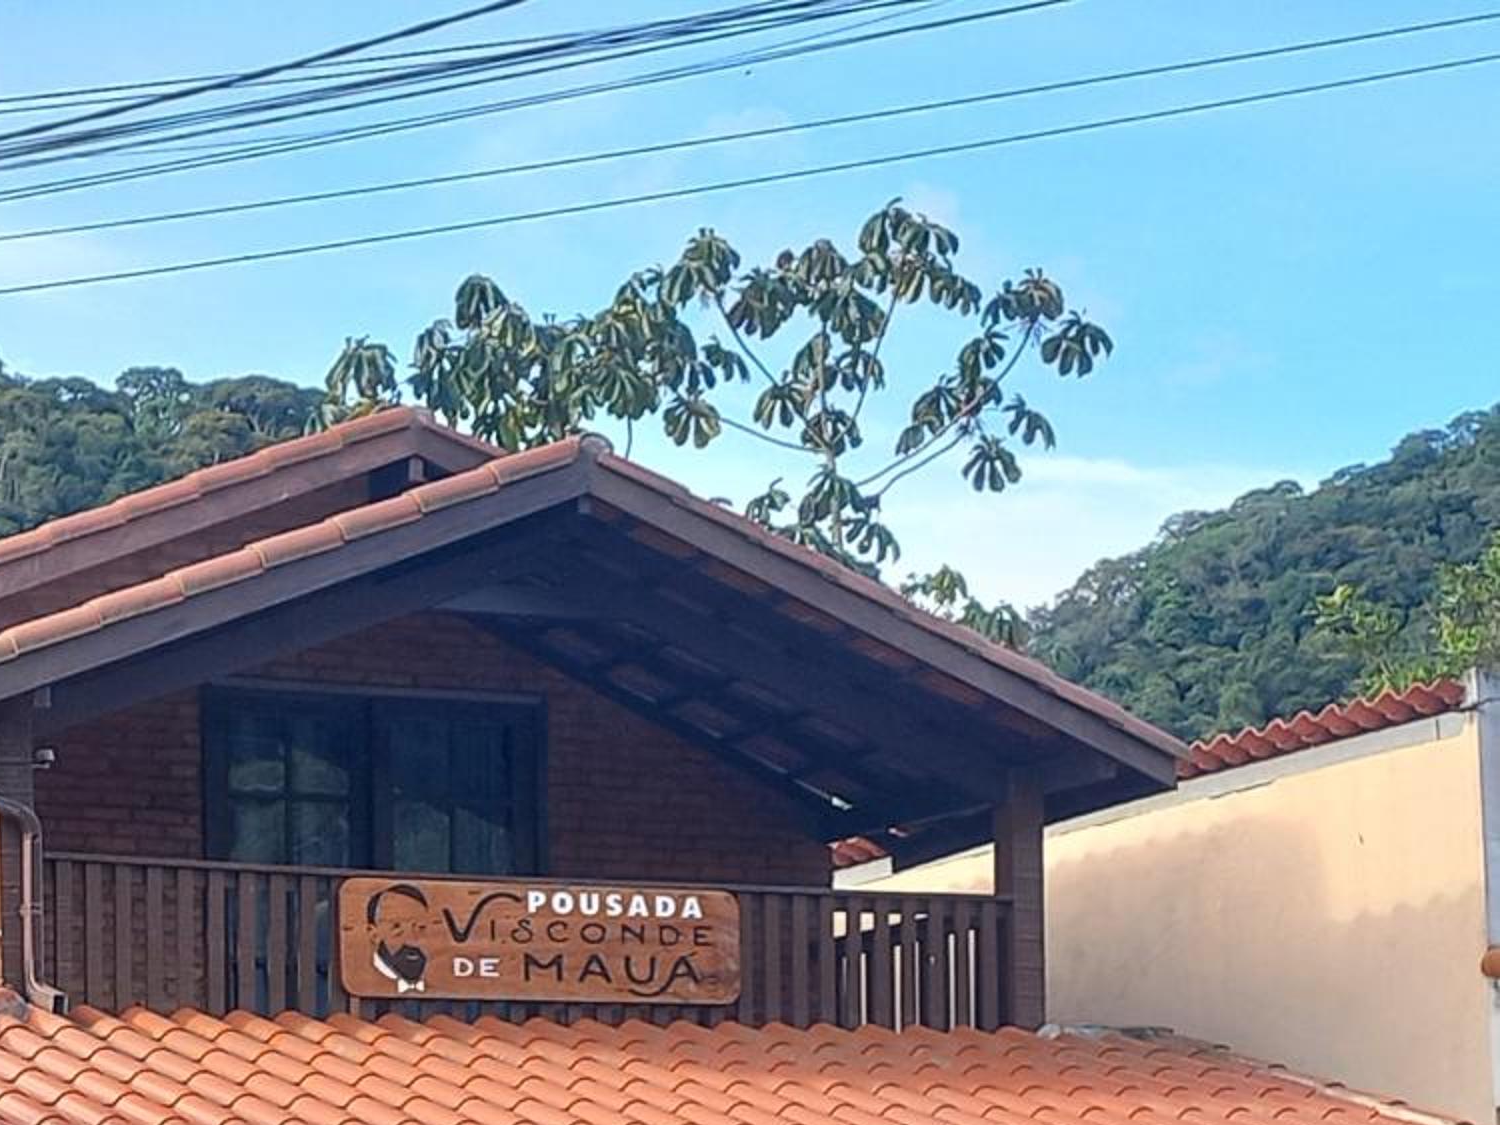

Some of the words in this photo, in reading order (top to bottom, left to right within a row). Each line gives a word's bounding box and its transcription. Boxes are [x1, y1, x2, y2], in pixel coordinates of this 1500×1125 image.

[527, 891, 702, 918] POUSADA
[443, 892, 713, 946] VISCONDE
[453, 956, 500, 977] DE
